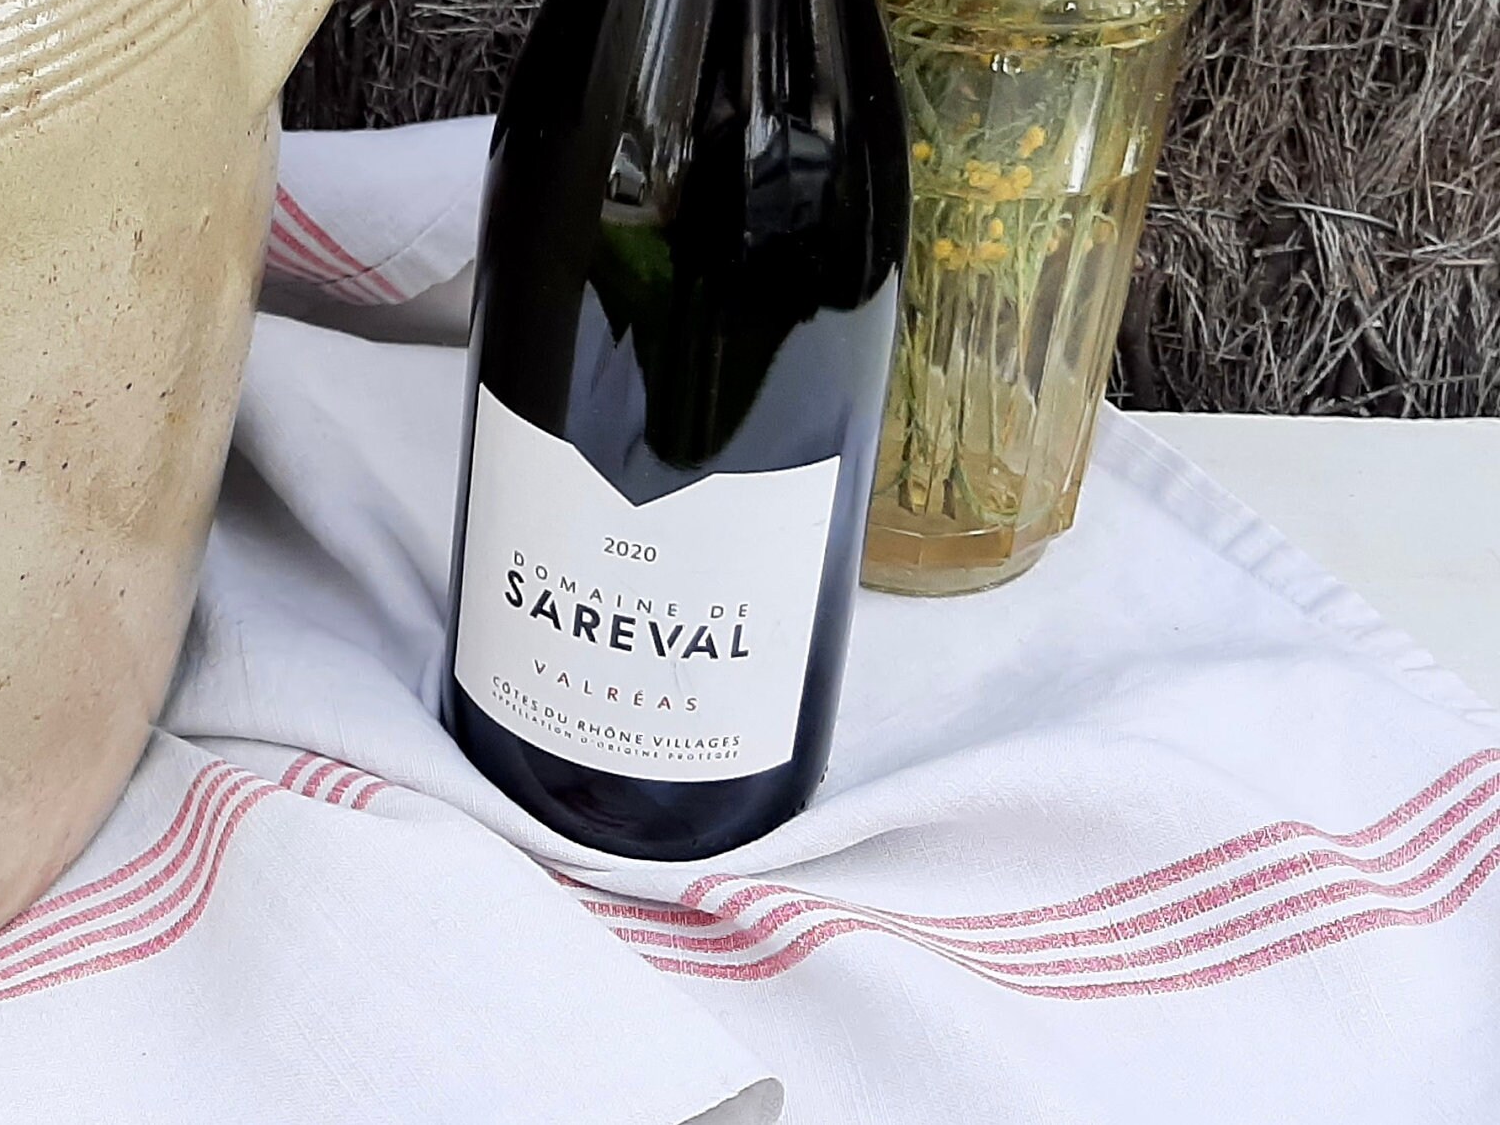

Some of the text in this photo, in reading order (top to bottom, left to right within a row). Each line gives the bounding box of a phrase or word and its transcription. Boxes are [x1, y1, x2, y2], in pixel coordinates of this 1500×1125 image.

[603, 537, 657, 563] 2020
[514, 550, 749, 619] DOMAINE DE
[504, 569, 749, 660] SAREVAL
[534, 659, 698, 712] VALRÉAS
[544, 706, 568, 724] DU
[577, 720, 644, 746] RHÔNE
[652, 735, 740, 749] VILLAGES
